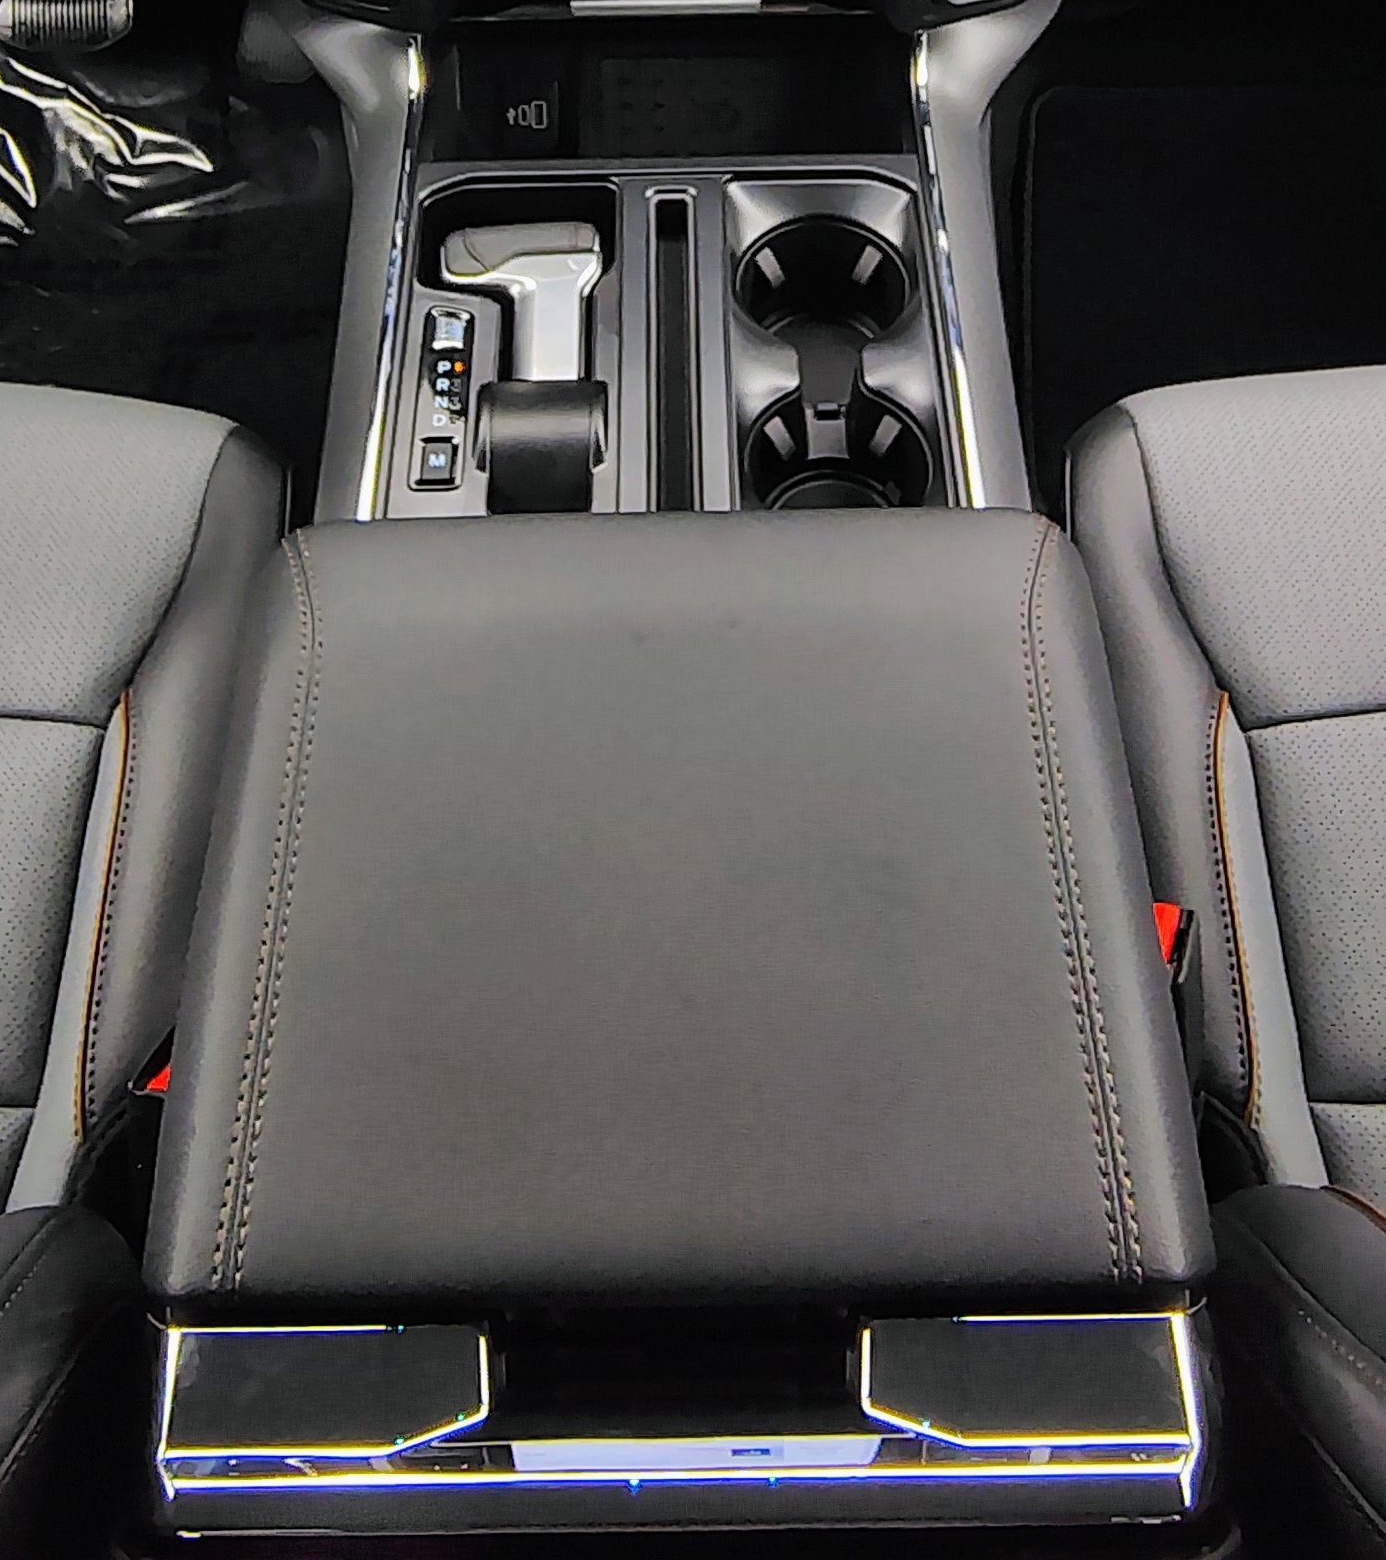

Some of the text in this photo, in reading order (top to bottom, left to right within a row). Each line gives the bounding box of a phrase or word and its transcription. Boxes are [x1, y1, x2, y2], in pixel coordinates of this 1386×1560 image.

[436, 360, 452, 375] P
[435, 377, 450, 393] R
[434, 395, 449, 410] N
[432, 413, 447, 428] D
[427, 452, 446, 468] M
